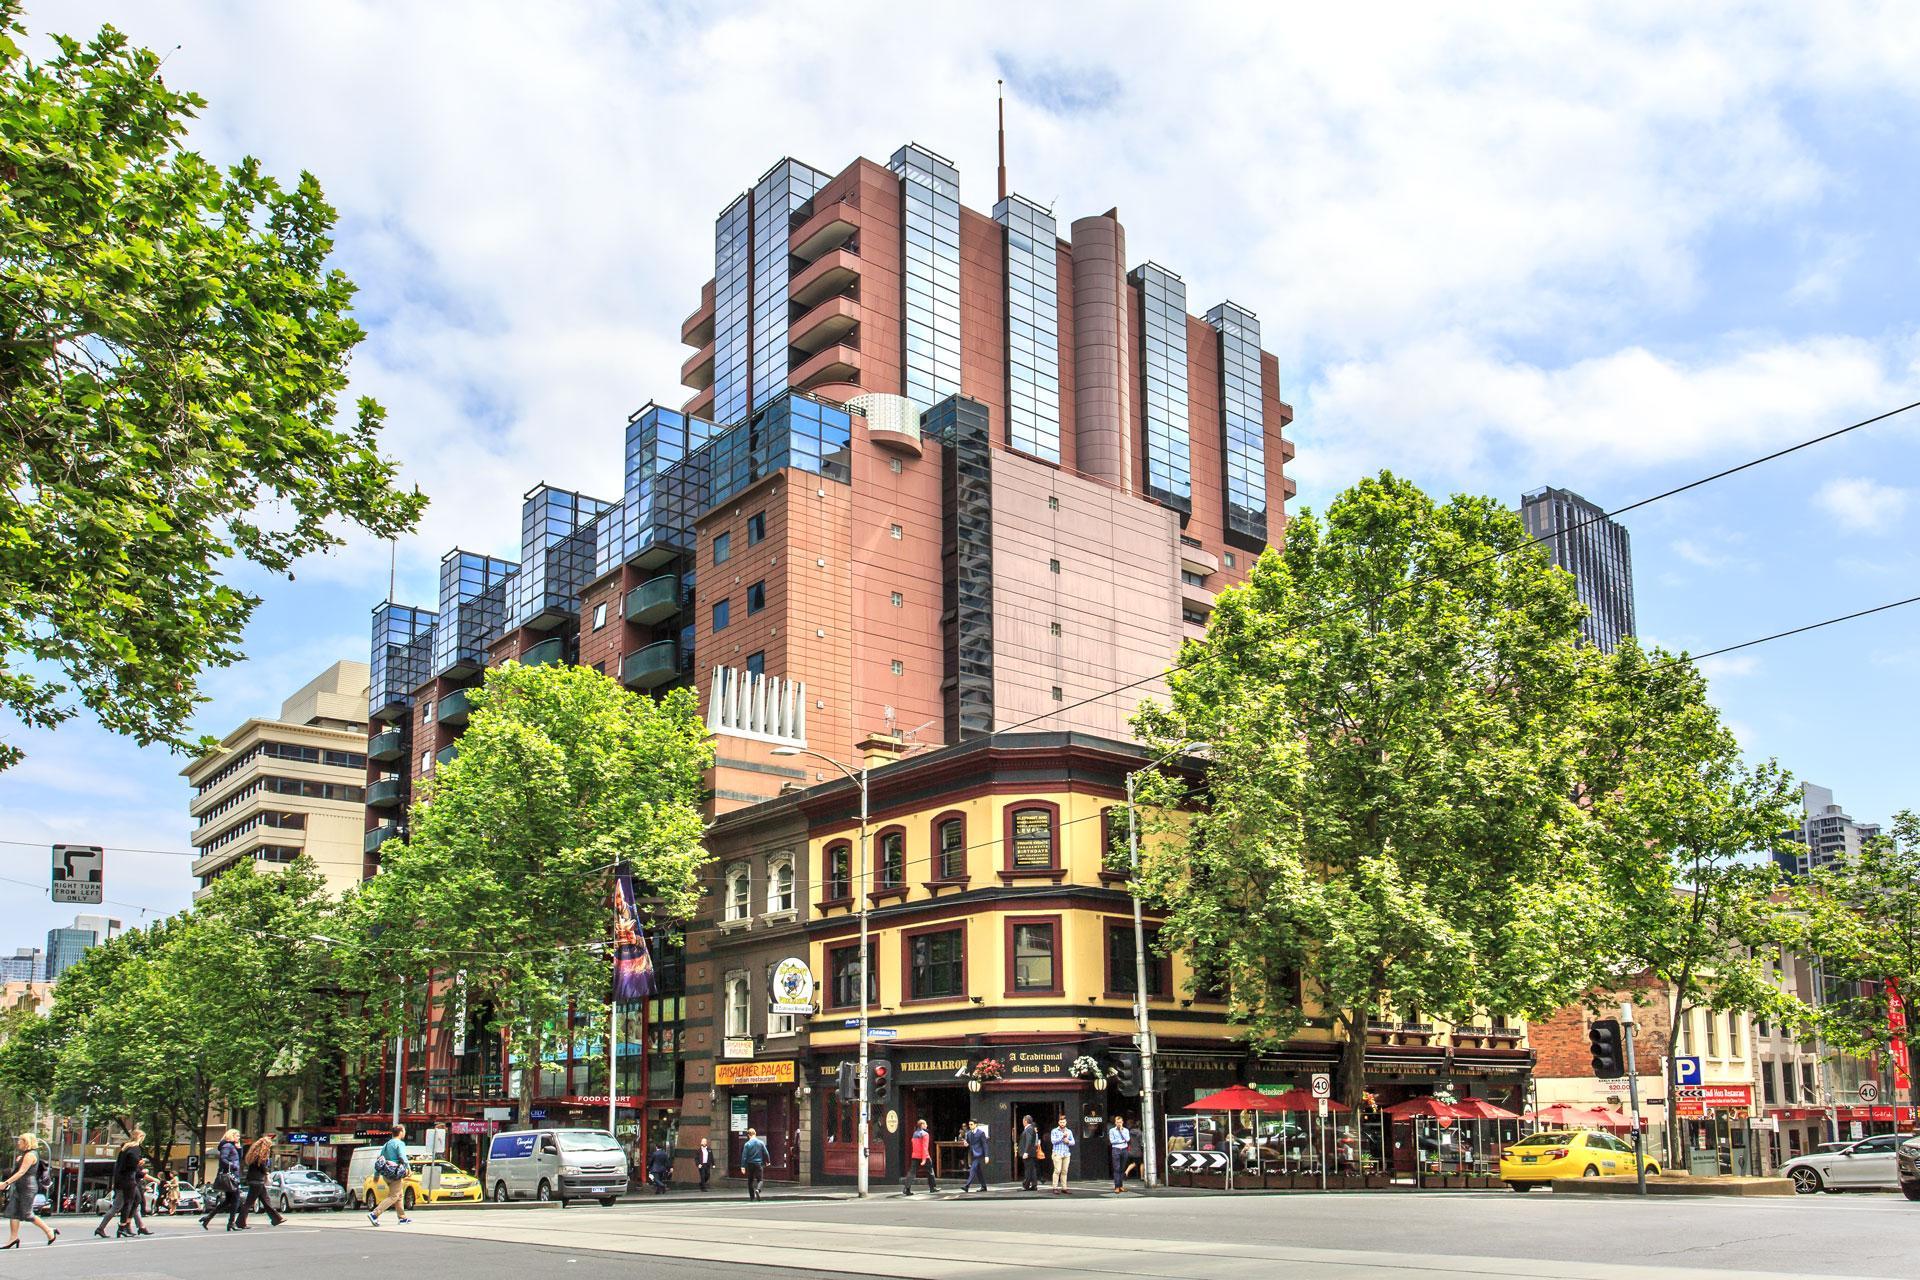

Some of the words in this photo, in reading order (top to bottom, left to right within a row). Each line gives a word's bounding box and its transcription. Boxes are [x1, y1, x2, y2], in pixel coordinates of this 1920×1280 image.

[1020, 1052, 1062, 1060] Traditional
[719, 1065, 760, 1078] JAISALMER
[762, 1063, 792, 1076] PALACE
[821, 1066, 836, 1075] THE
[900, 1060, 969, 1072] WHEELBARROW
[1012, 1064, 1040, 1073] British
[1042, 1064, 1060, 1074] Pub
[1676, 1059, 1696, 1084] P
[1314, 1081, 1328, 1090] 40
[1258, 1088, 1284, 1096] Heineken
[1861, 1088, 1876, 1097] 40
[188, 1156, 198, 1166] P
